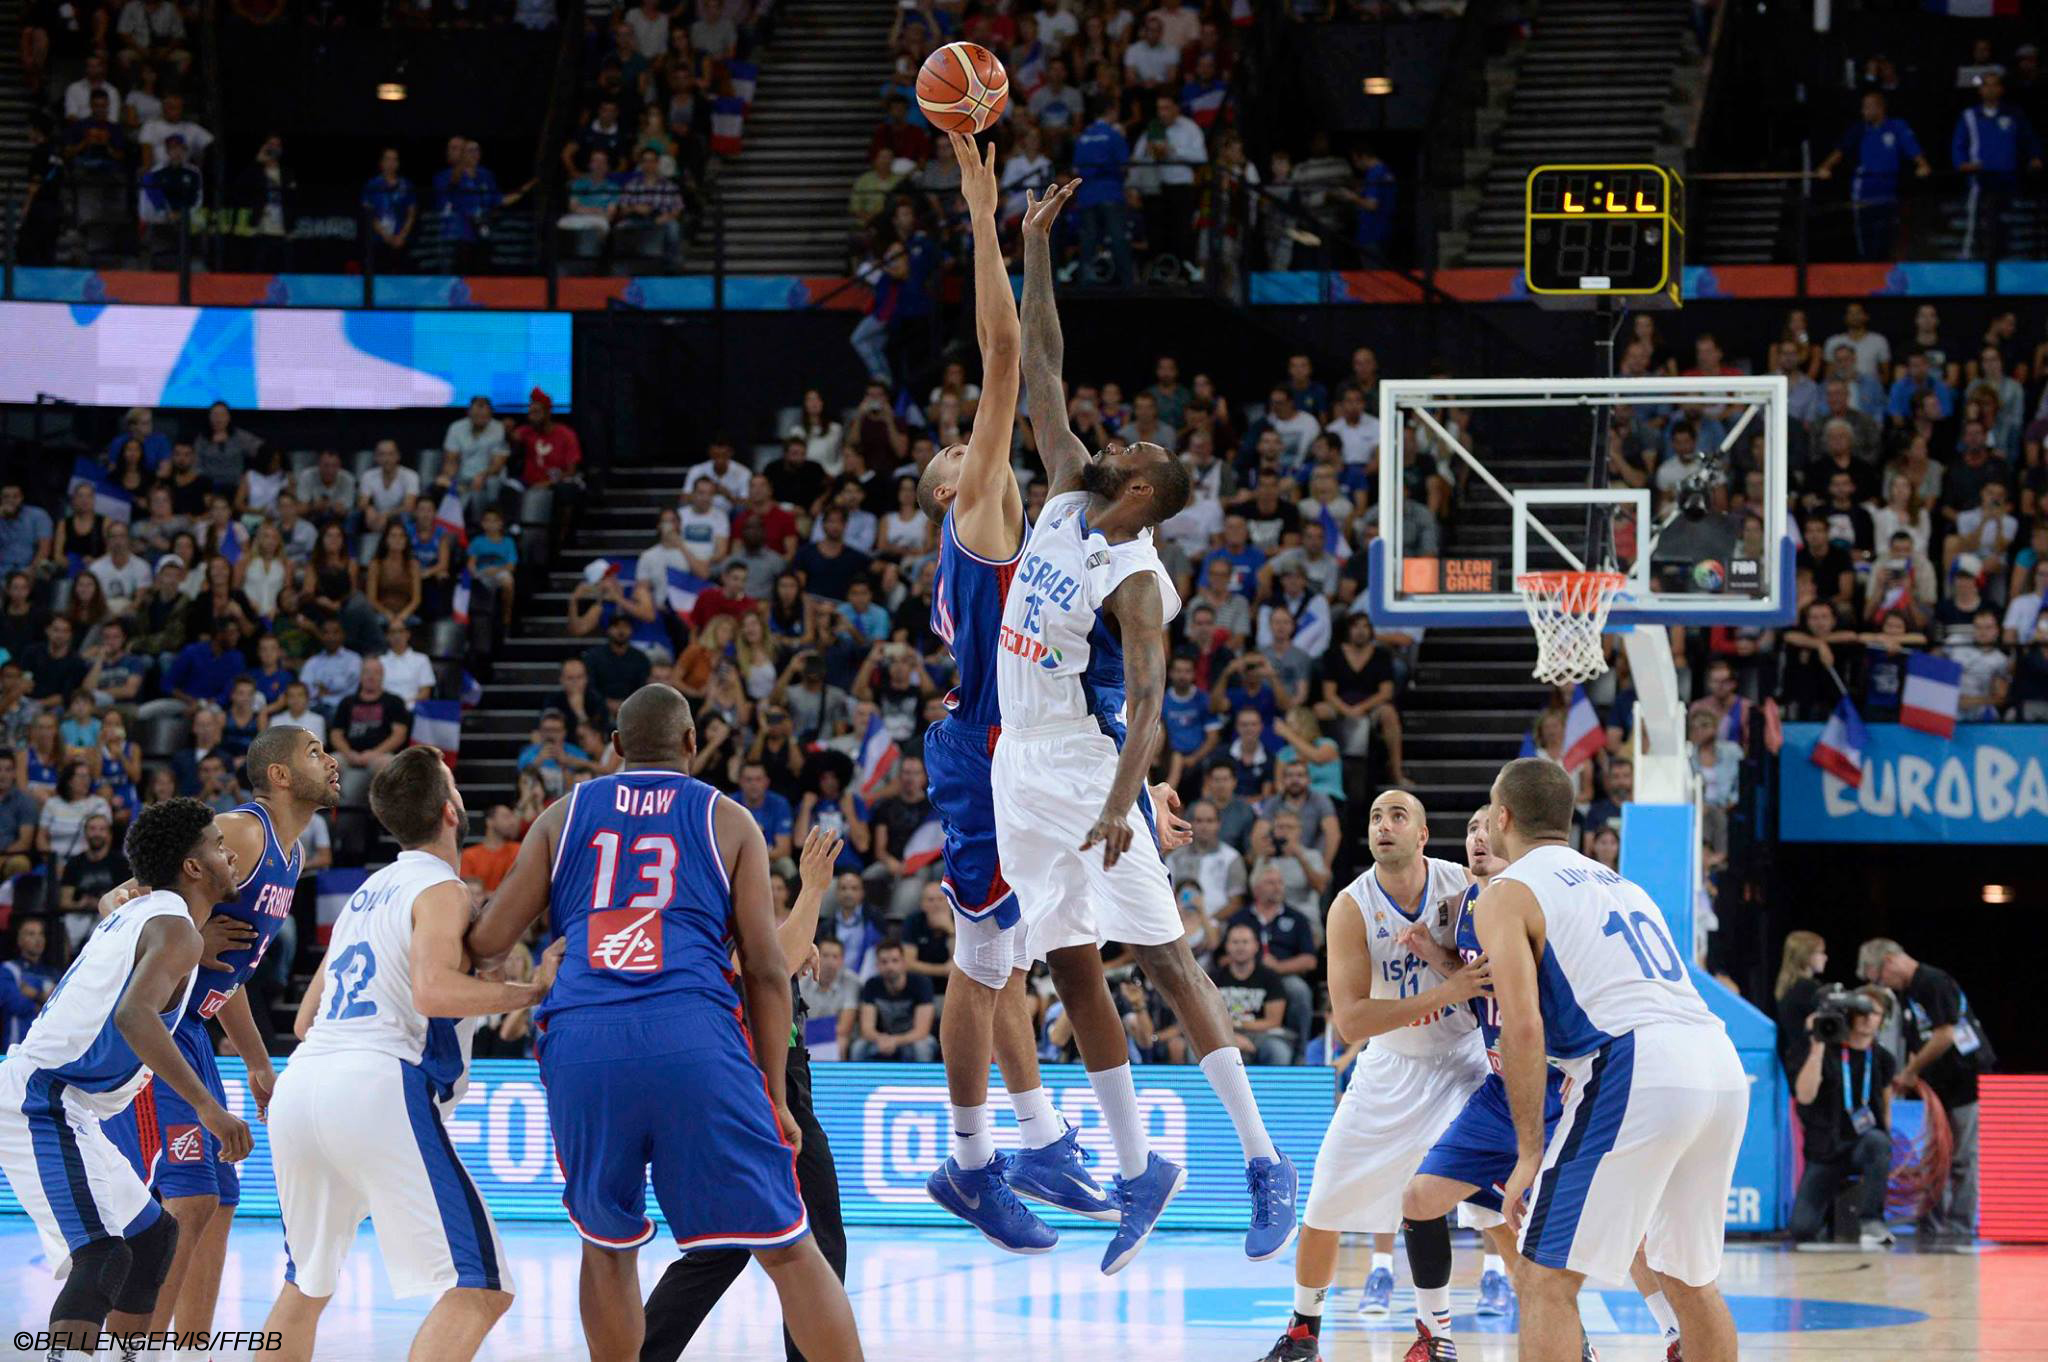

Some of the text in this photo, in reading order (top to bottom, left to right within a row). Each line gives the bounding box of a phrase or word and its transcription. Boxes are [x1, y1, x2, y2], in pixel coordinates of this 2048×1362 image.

[1018, 552, 1080, 612] ISRAEL
[1445, 559, 1493, 576] CLEAN
[1445, 576, 1493, 592] GAME
[1732, 560, 1757, 575] FIBA
[1023, 592, 1044, 634] 15
[615, 784, 676, 815] DIAW
[588, 829, 679, 909] 13
[1602, 910, 1683, 982] 10
[328, 941, 378, 1020] 12
